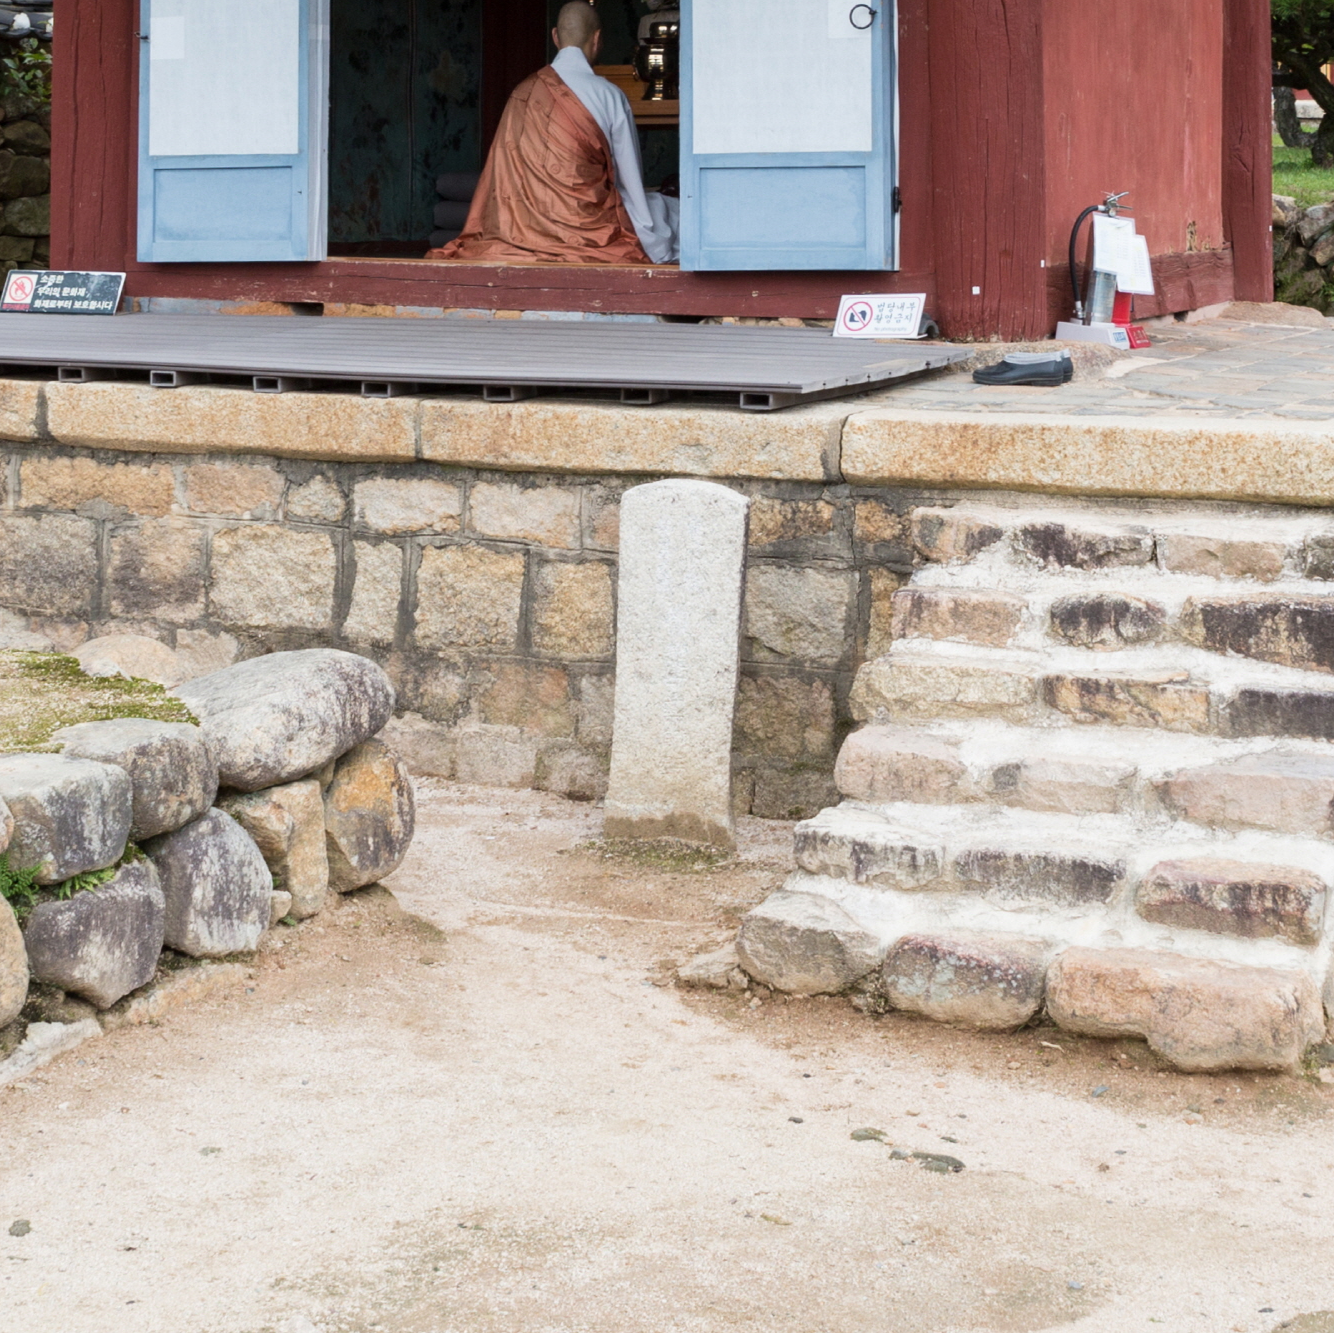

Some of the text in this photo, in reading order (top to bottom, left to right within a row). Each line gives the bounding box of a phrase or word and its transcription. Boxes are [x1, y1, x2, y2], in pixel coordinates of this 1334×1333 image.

[40, 274, 64, 284] 소중한
[36, 287, 86, 297] 우리의 문화재
[33, 299, 72, 309] 화재로부터
[73, 300, 113, 310] 보호합시다
